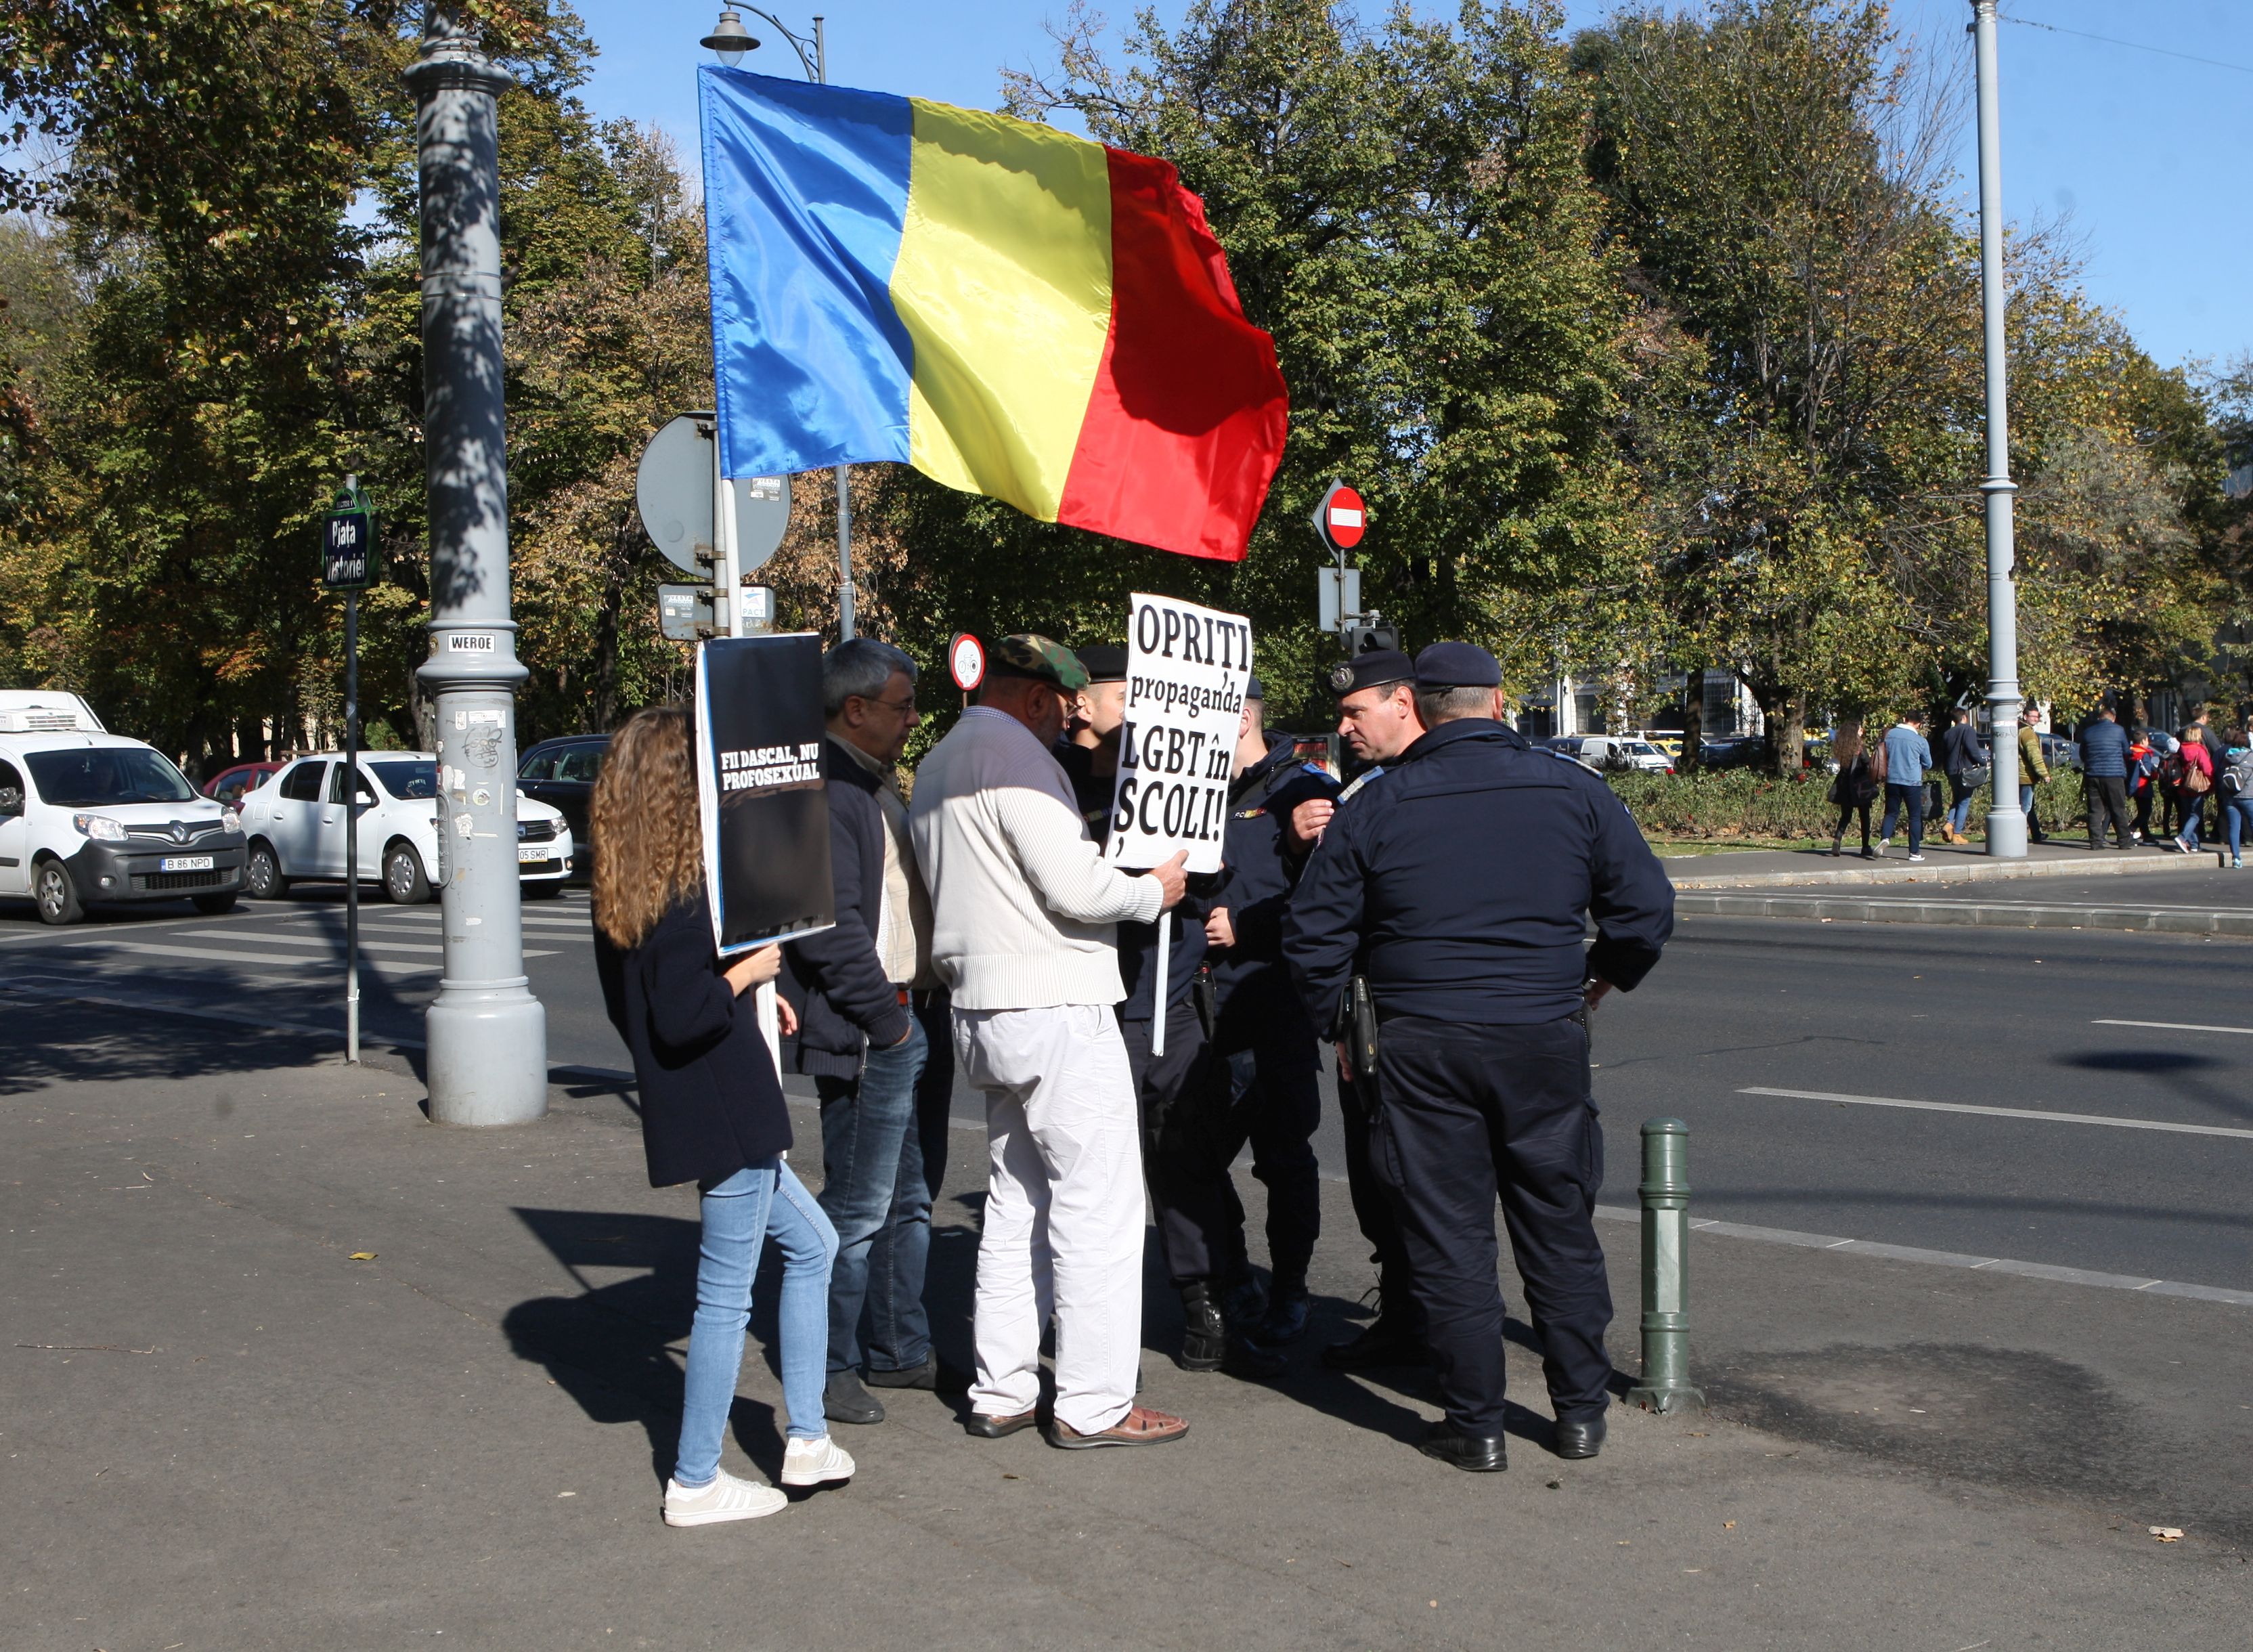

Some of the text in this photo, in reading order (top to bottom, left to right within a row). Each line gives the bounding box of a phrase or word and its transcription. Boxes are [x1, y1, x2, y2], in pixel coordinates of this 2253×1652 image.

[326, 552, 365, 582] Victoriei
[452, 637, 491, 649] WEROE
[1129, 676, 1242, 718] propaganda
[720, 743, 819, 770] FII DASCAL, NU
[1122, 721, 1229, 781] LGBT în
[722, 762, 820, 791] PROFOSEXUAL
[167, 860, 174, 869] B
[177, 859, 188, 868] 86
[530, 850, 546, 858] SMR
